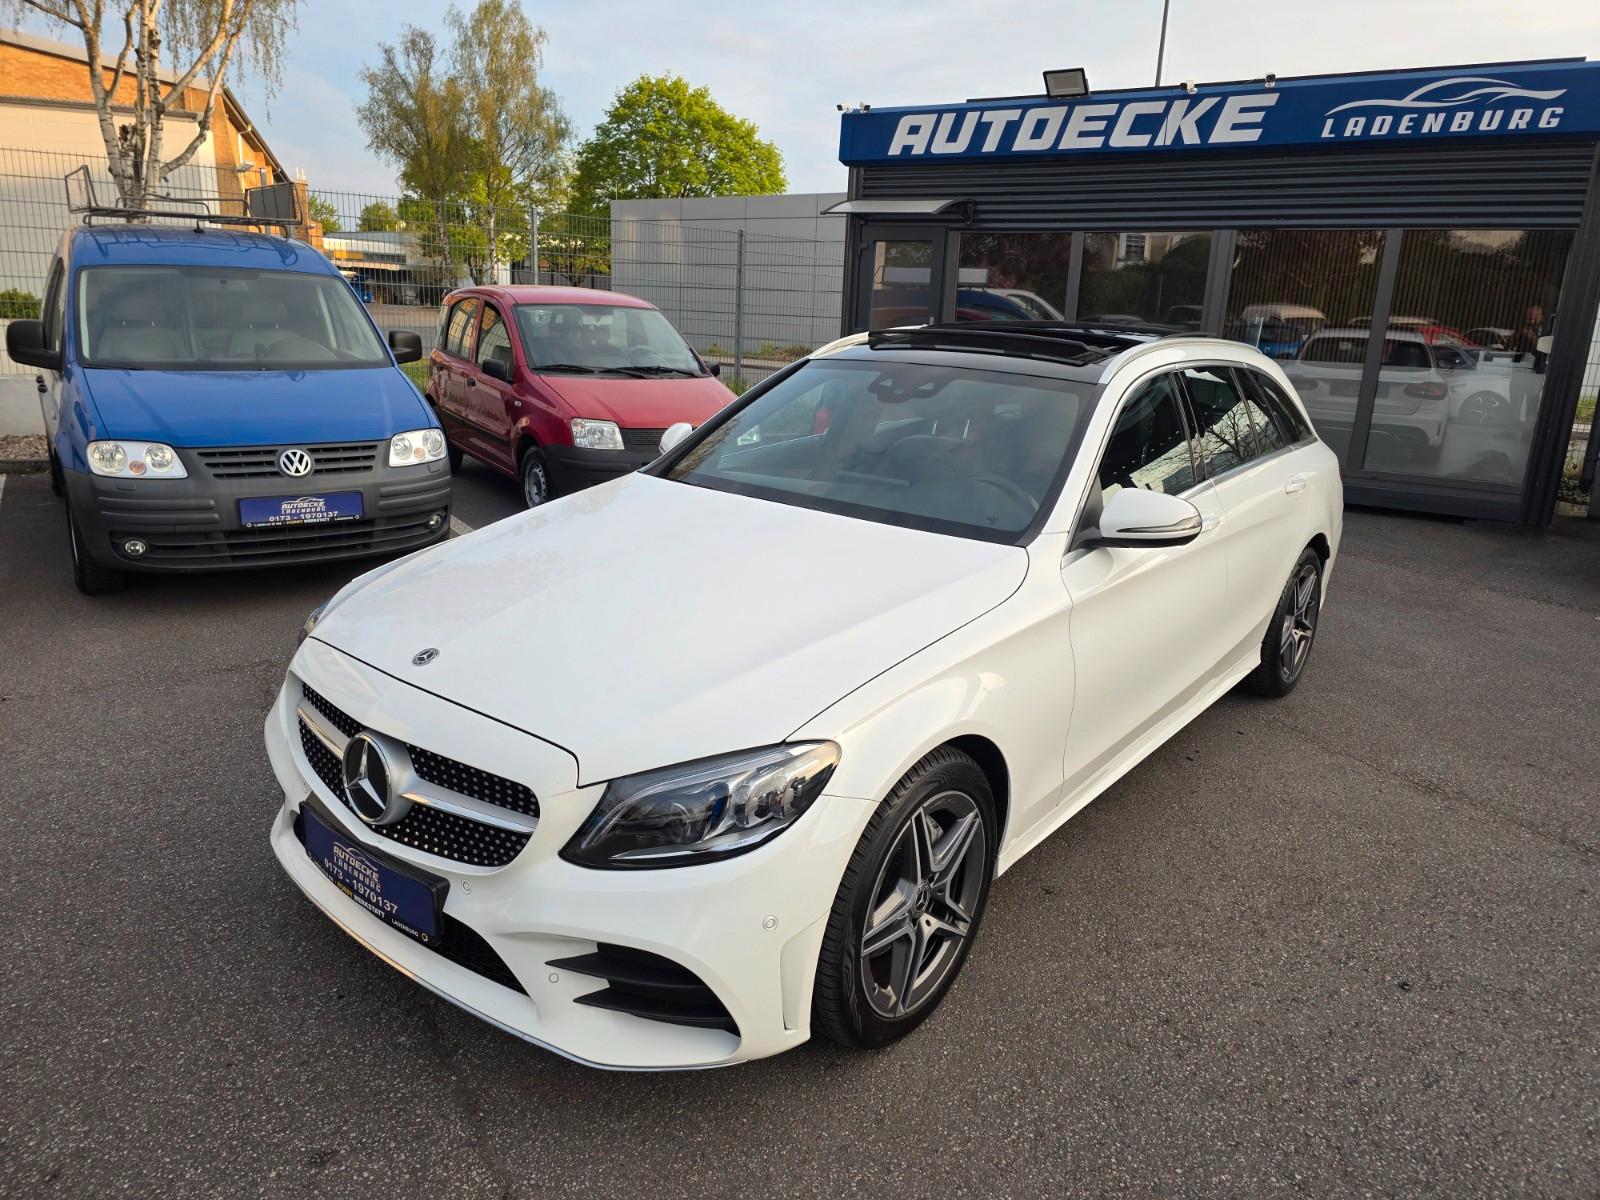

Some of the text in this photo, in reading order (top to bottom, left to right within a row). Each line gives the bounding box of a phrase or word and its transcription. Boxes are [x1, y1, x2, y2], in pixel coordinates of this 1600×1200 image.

[887, 92, 1280, 156] AUTOECKE
[1321, 107, 1565, 138] LADENBURG
[281, 501, 325, 510] AUTOECKE
[281, 506, 326, 514] LADENBURG
[300, 511, 339, 520] 1970137
[333, 845, 380, 882] AUTOECKE
[333, 855, 382, 893] LADENBURG
[324, 857, 344, 880] 0173
[352, 879, 399, 914] 1970137
